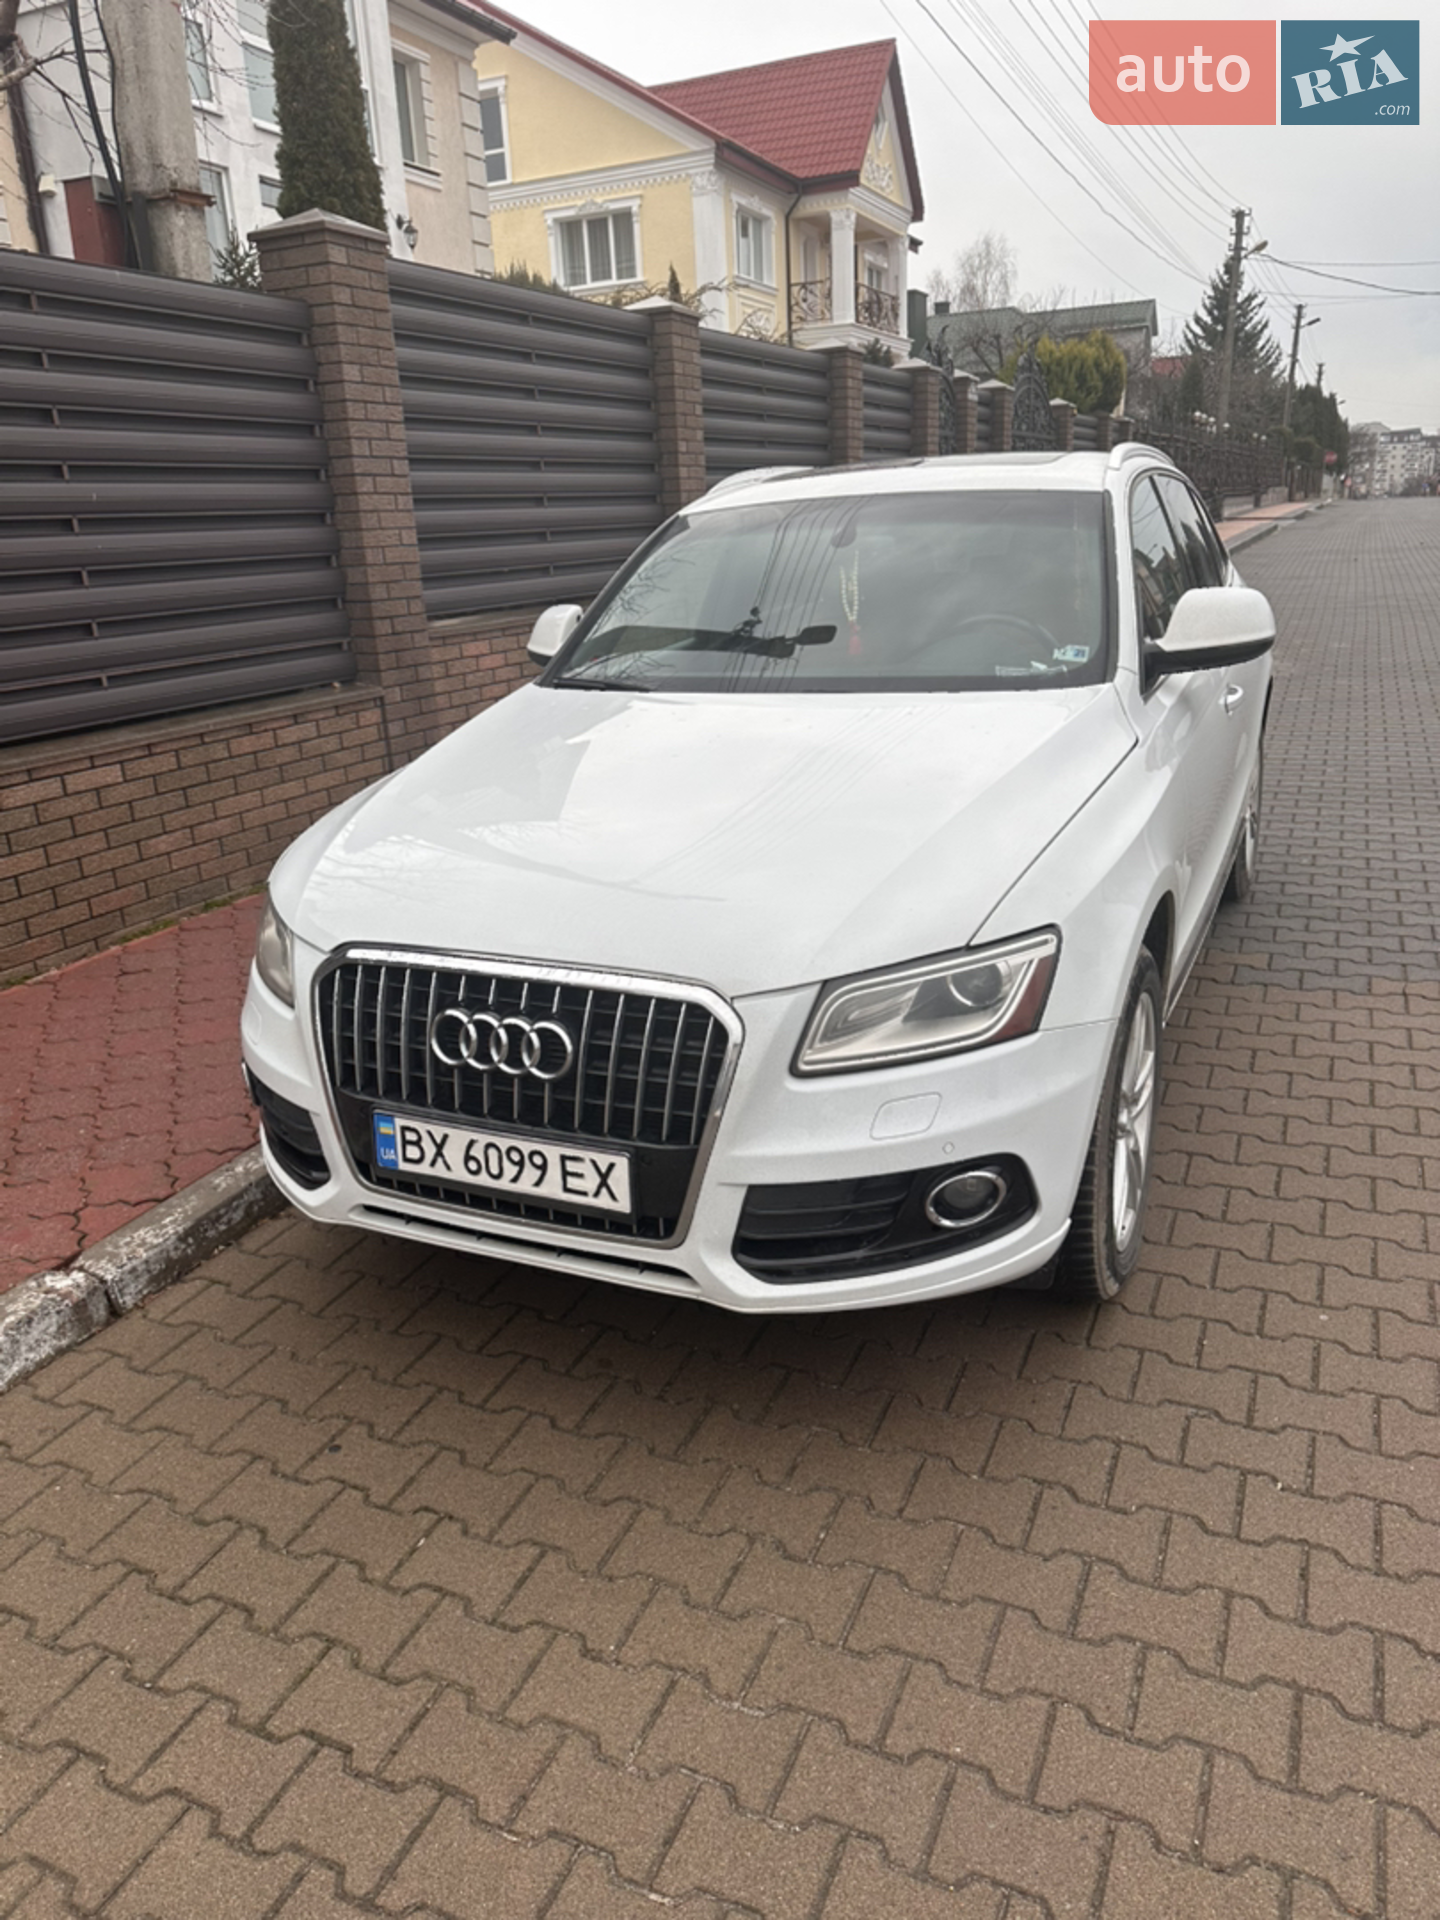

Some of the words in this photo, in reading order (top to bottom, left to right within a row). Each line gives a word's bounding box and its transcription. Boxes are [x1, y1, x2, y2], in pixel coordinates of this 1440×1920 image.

[380, 1147, 397, 1161] UA
[400, 1125, 453, 1172] BX
[463, 1138, 549, 1187] 6099
[559, 1153, 620, 1203] EX
